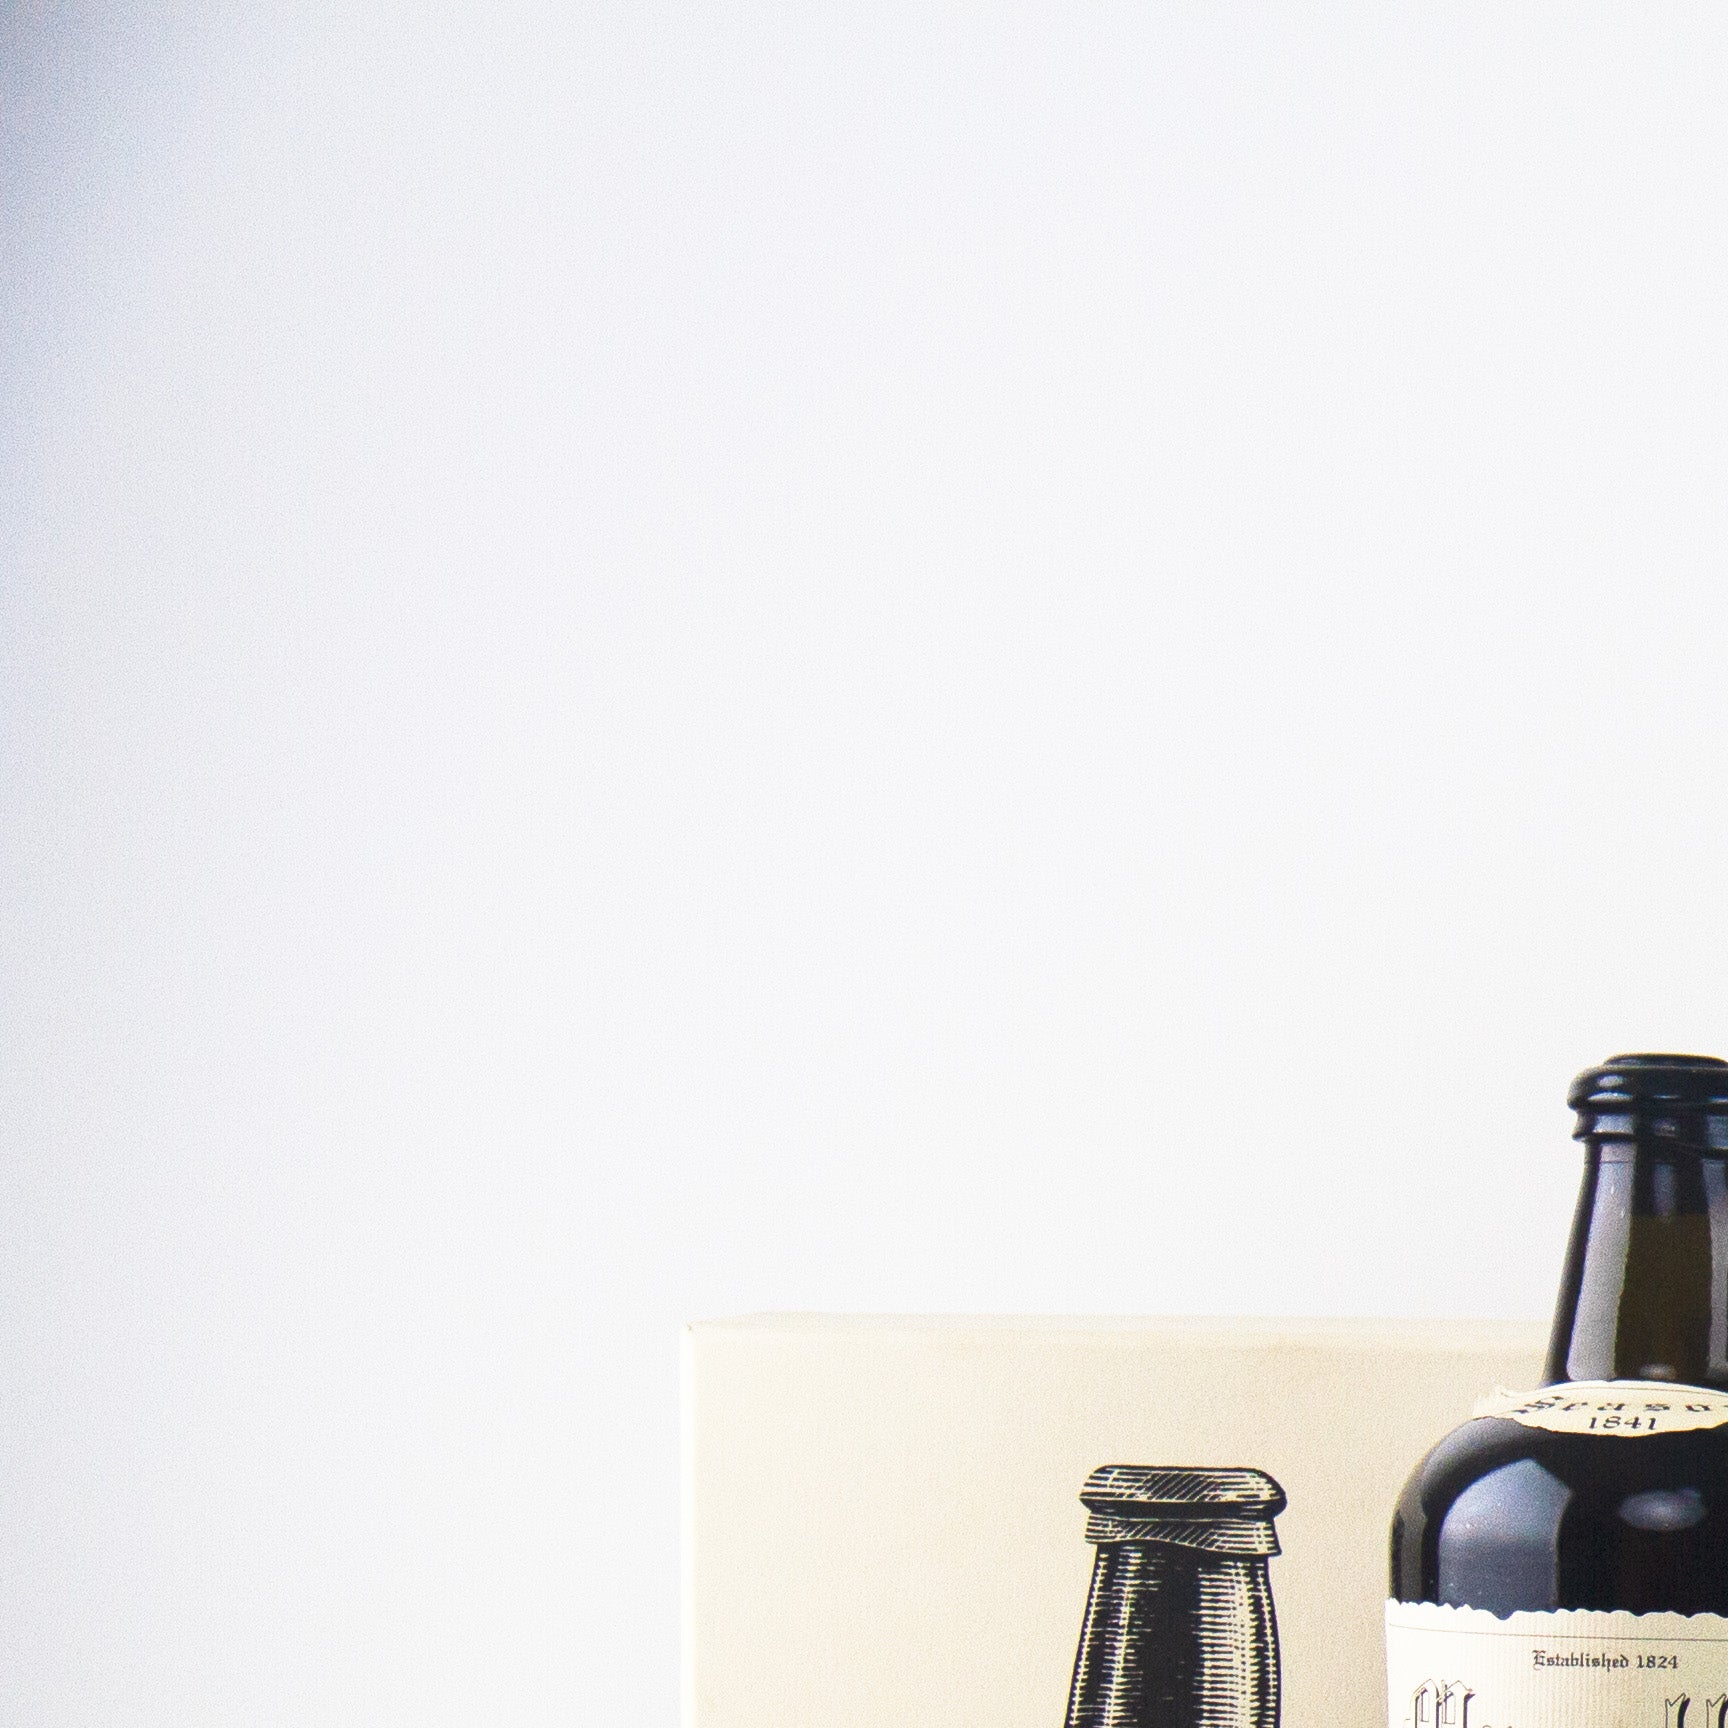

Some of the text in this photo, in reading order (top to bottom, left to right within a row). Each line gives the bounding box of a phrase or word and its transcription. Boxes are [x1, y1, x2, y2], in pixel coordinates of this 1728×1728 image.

[1588, 1415, 1658, 1432] 1841
[1532, 1650, 1680, 1674] Established 1824
